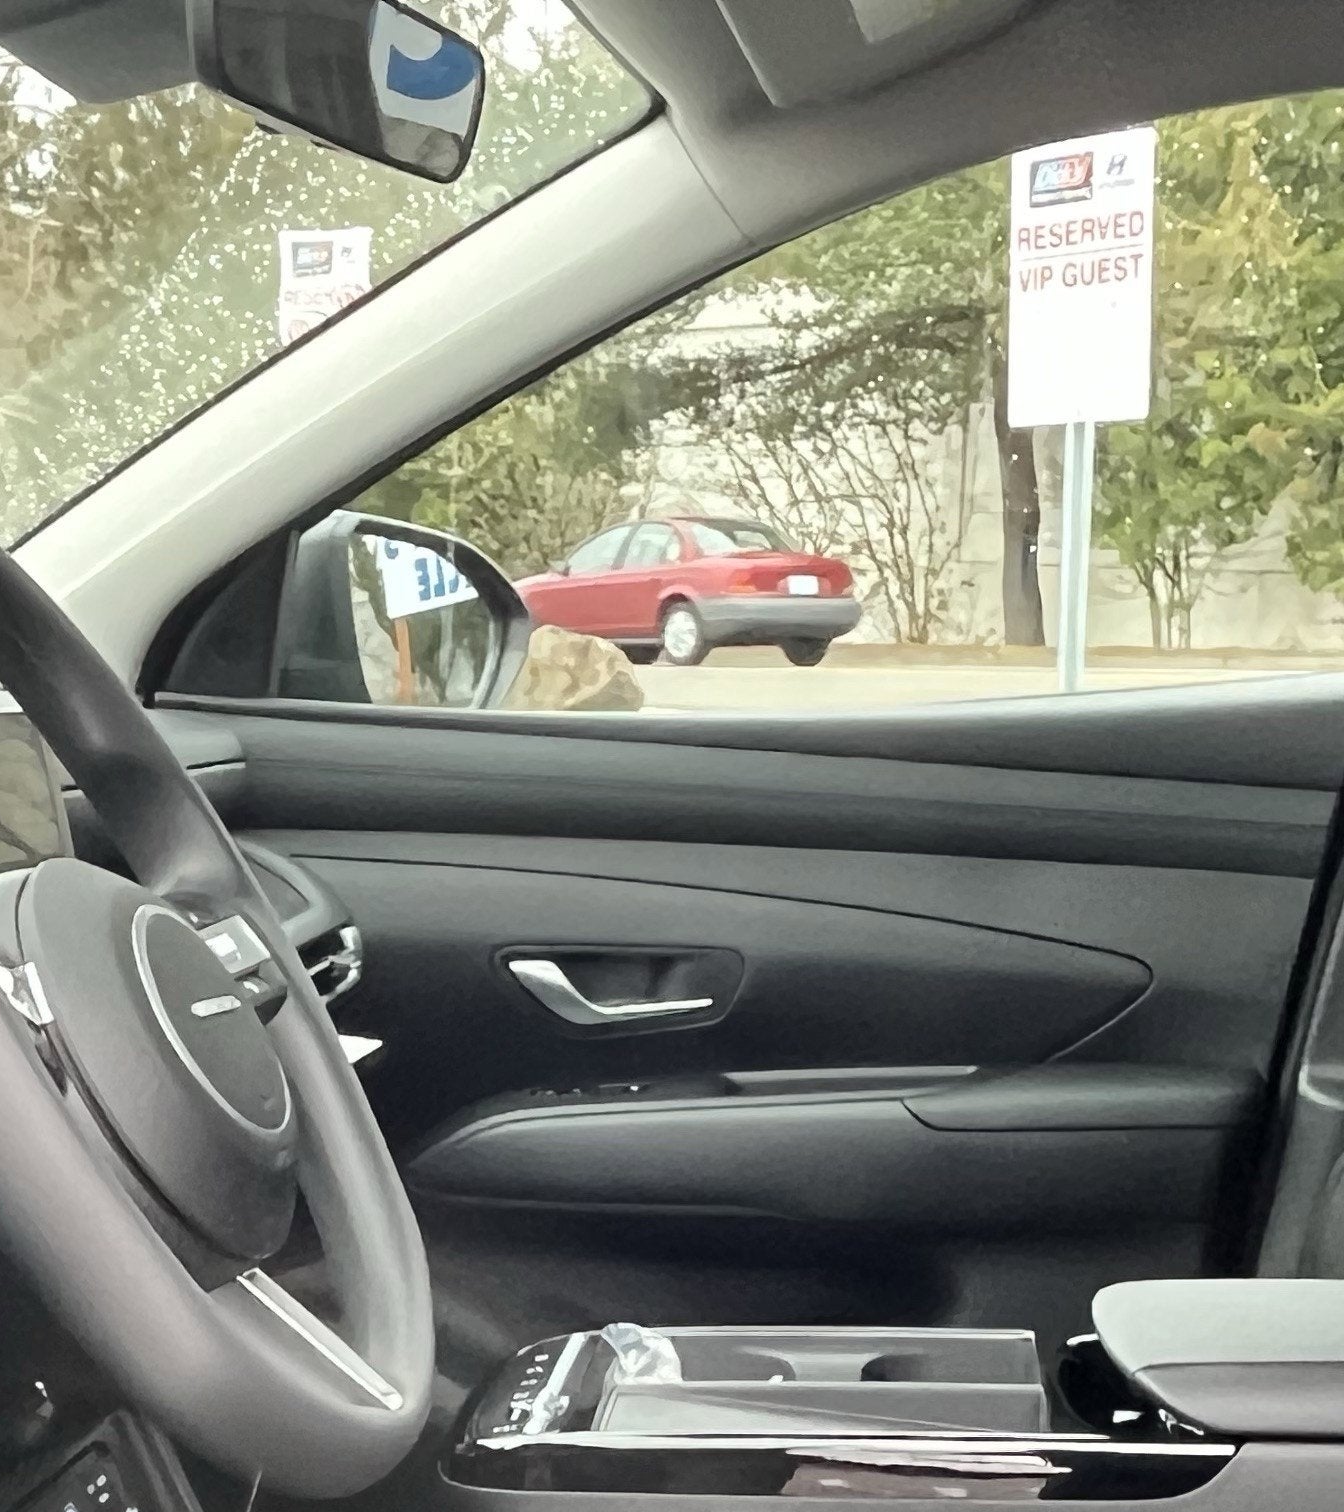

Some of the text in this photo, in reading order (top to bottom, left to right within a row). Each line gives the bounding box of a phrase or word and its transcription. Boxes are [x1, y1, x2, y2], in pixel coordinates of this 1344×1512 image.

[1017, 210, 1145, 251] RESERVED
[1019, 253, 1144, 293] VIP GUEST
